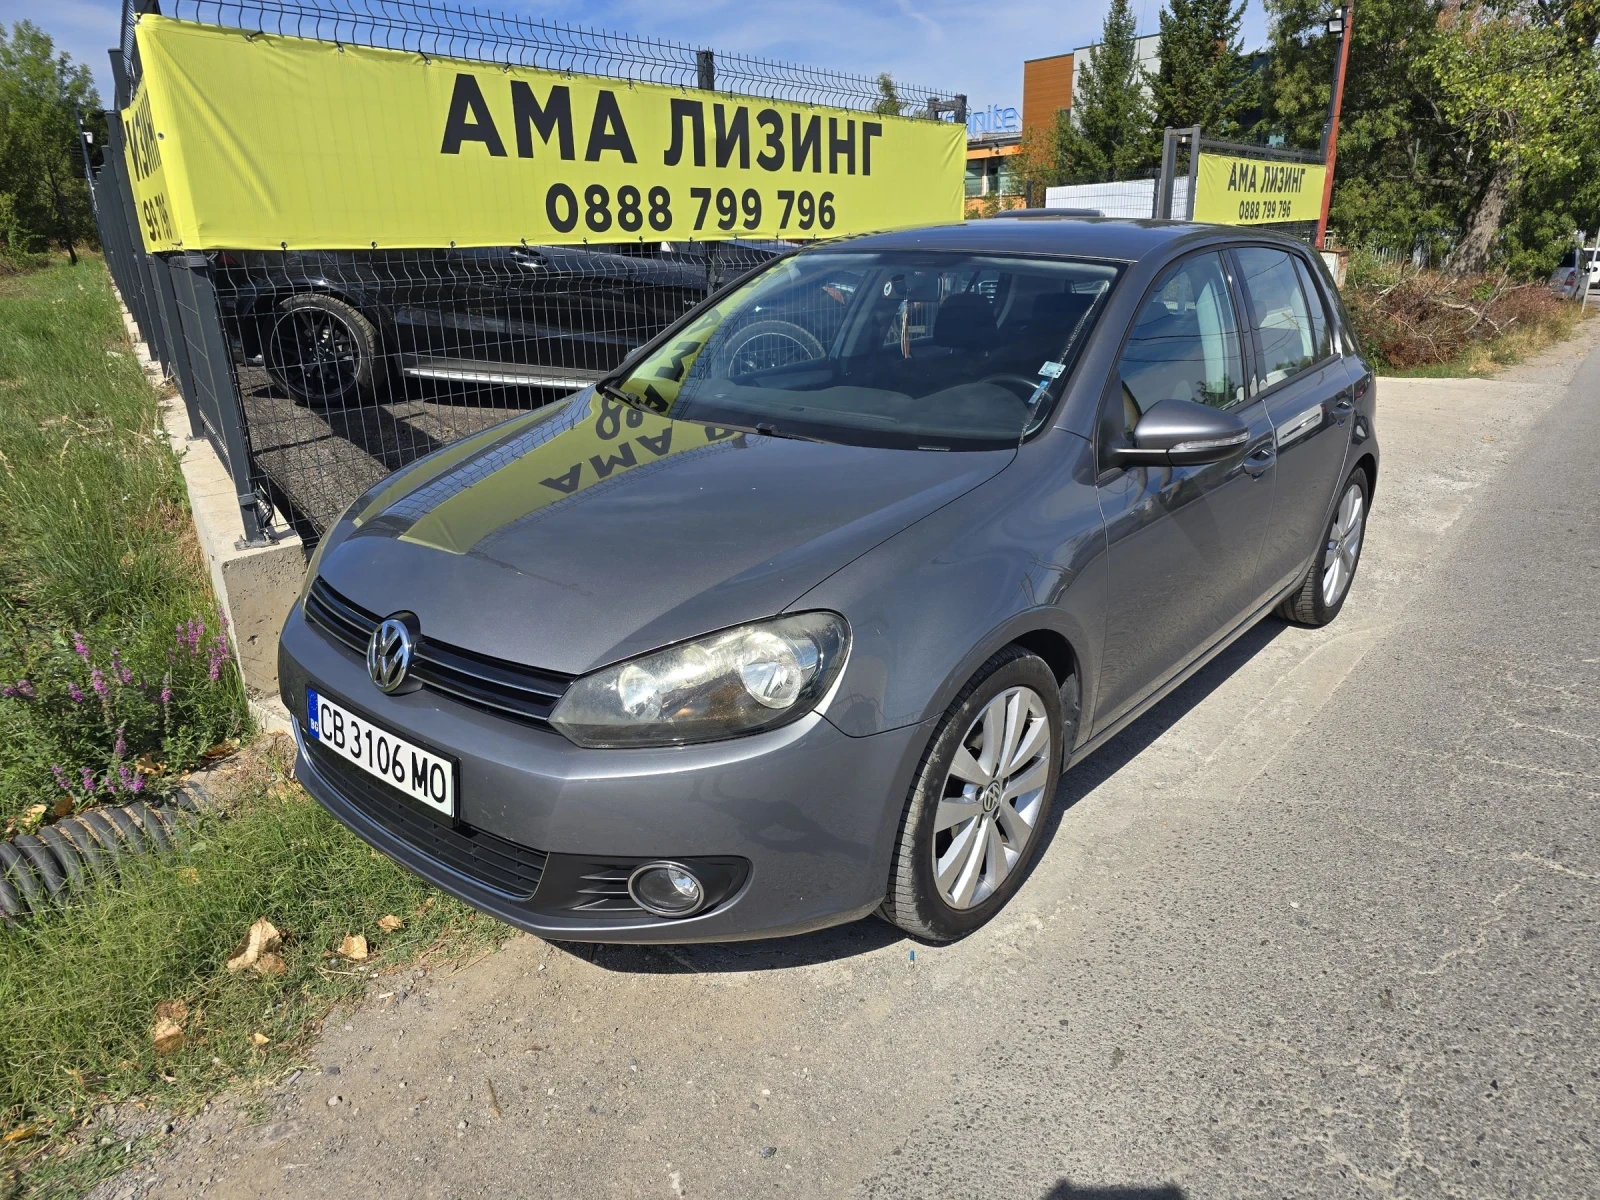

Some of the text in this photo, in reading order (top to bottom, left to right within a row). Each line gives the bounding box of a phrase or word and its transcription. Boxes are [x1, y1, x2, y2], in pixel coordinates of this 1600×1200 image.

[441, 73, 883, 177] АМА ЛИЗИНГ
[966, 103, 1017, 133] nite
[1227, 162, 1306, 193] АМА ЛИЗИНГ
[545, 182, 836, 233] 0888 799 796
[1238, 200, 1292, 220] 0888 799 796
[310, 717, 319, 733] BG
[321, 703, 447, 804] CB 3106 MO
